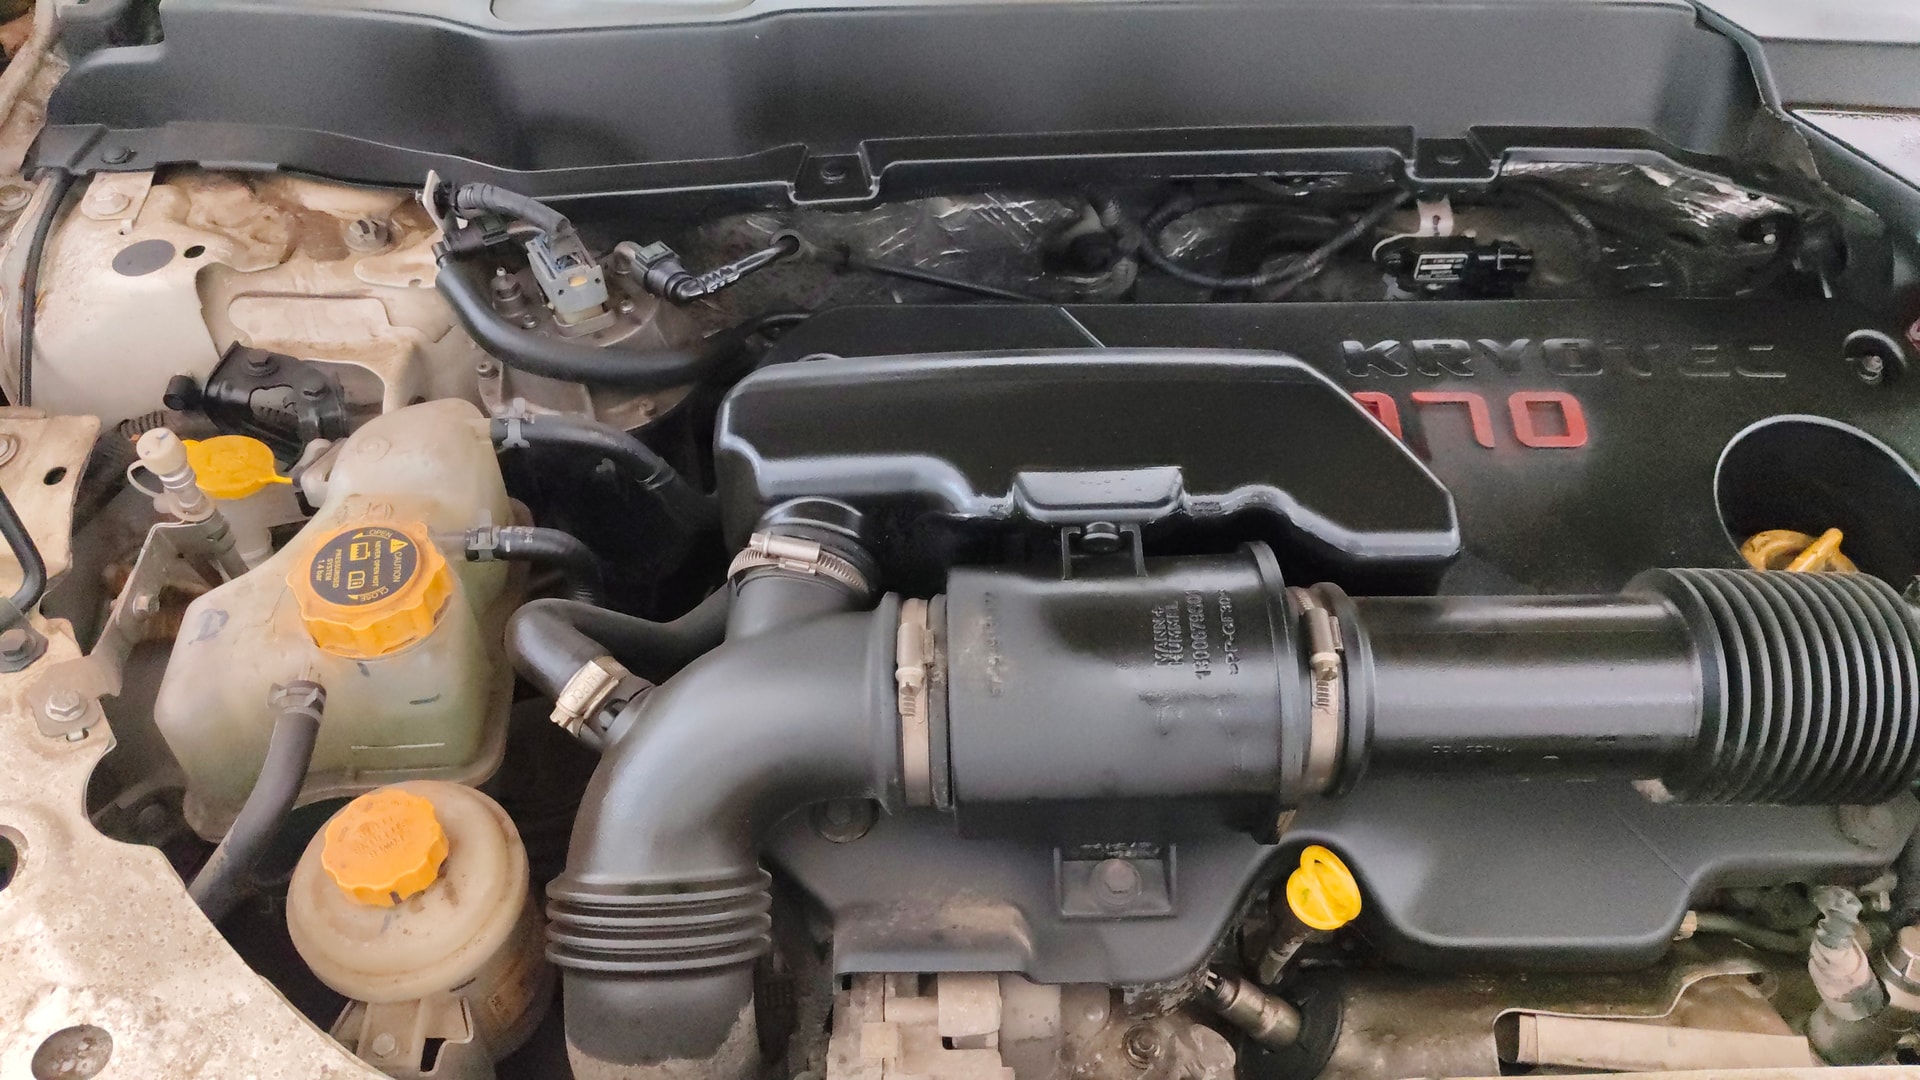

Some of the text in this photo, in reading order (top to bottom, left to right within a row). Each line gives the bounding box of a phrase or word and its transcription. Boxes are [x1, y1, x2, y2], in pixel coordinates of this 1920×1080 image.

[1342, 338, 1787, 378] KRYOTEC
[368, 529, 393, 539] OPEN
[374, 540, 382, 559] NEVER
[325, 558, 334, 581] SYSTEM
[373, 559, 381, 575] OPEN
[393, 551, 403, 583] CAUTION
[360, 586, 389, 601] CLOSE
